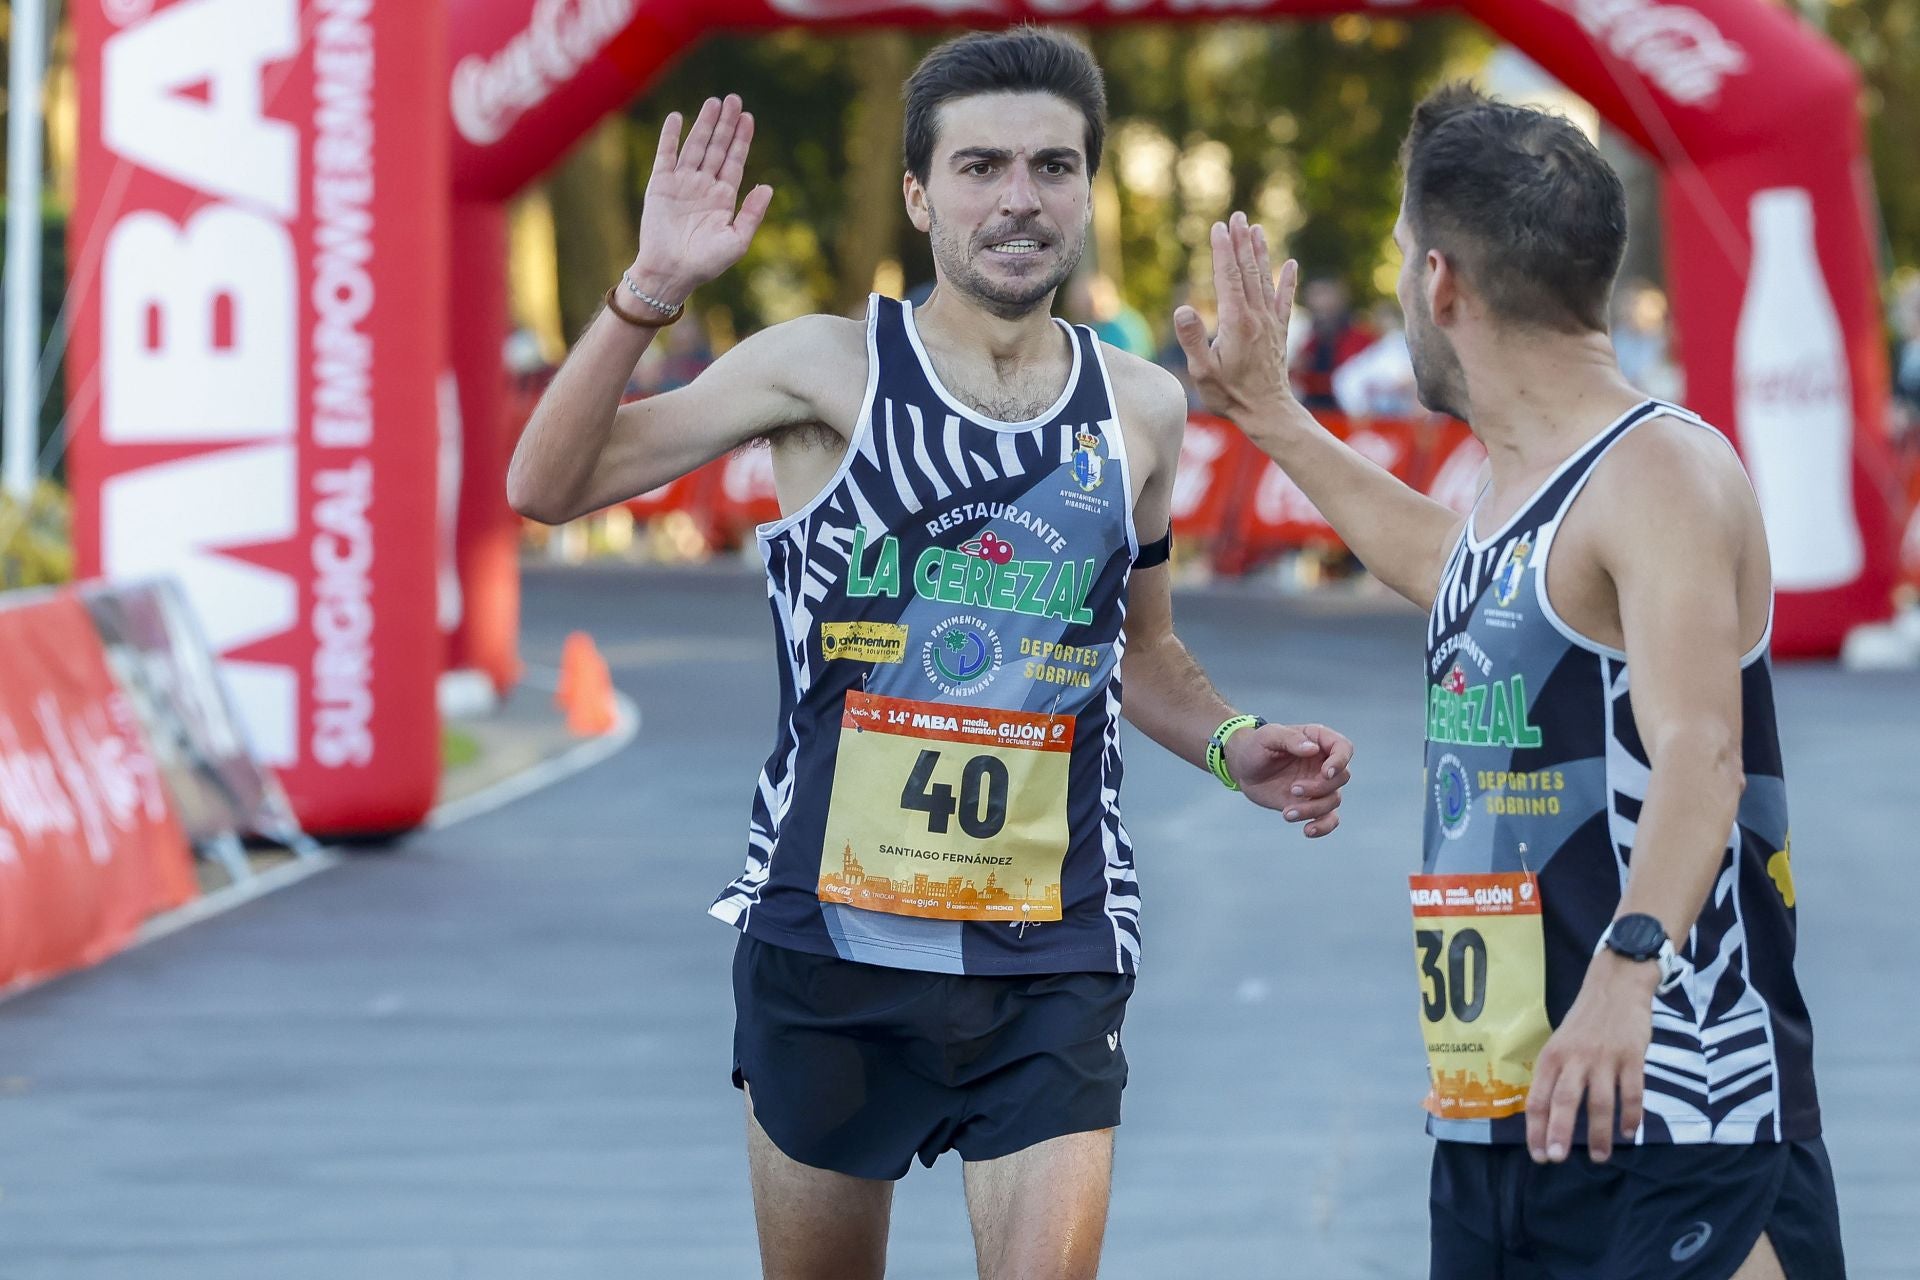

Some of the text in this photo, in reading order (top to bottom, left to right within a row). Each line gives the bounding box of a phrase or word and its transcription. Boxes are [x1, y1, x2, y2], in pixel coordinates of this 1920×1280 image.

[103, 0, 299, 767] MBA
[925, 501, 1067, 554] RESTAURANTE
[846, 523, 1096, 625] LA CEREZAL
[312, 458, 374, 766] SURGICAL
[922, 615, 1002, 697] PAVIMENTOS VETUSTA PAVIMENTOS VETUSTA
[1020, 637, 1099, 667] DEPORTES
[1024, 661, 1091, 688] SOBRINO
[911, 713, 959, 732] MBA
[961, 726, 997, 736] maratón
[962, 718, 989, 728] media
[998, 722, 1046, 741] GIJÓN
[1006, 738, 1030, 746] OCTUBRE
[900, 748, 1009, 839] 40
[1477, 770, 1565, 791] DEPORTES
[1486, 795, 1559, 816] SOBRINO
[879, 844, 1013, 866] SANTIAGO FERNÁNDEZ
[1416, 928, 1488, 1022] 30
